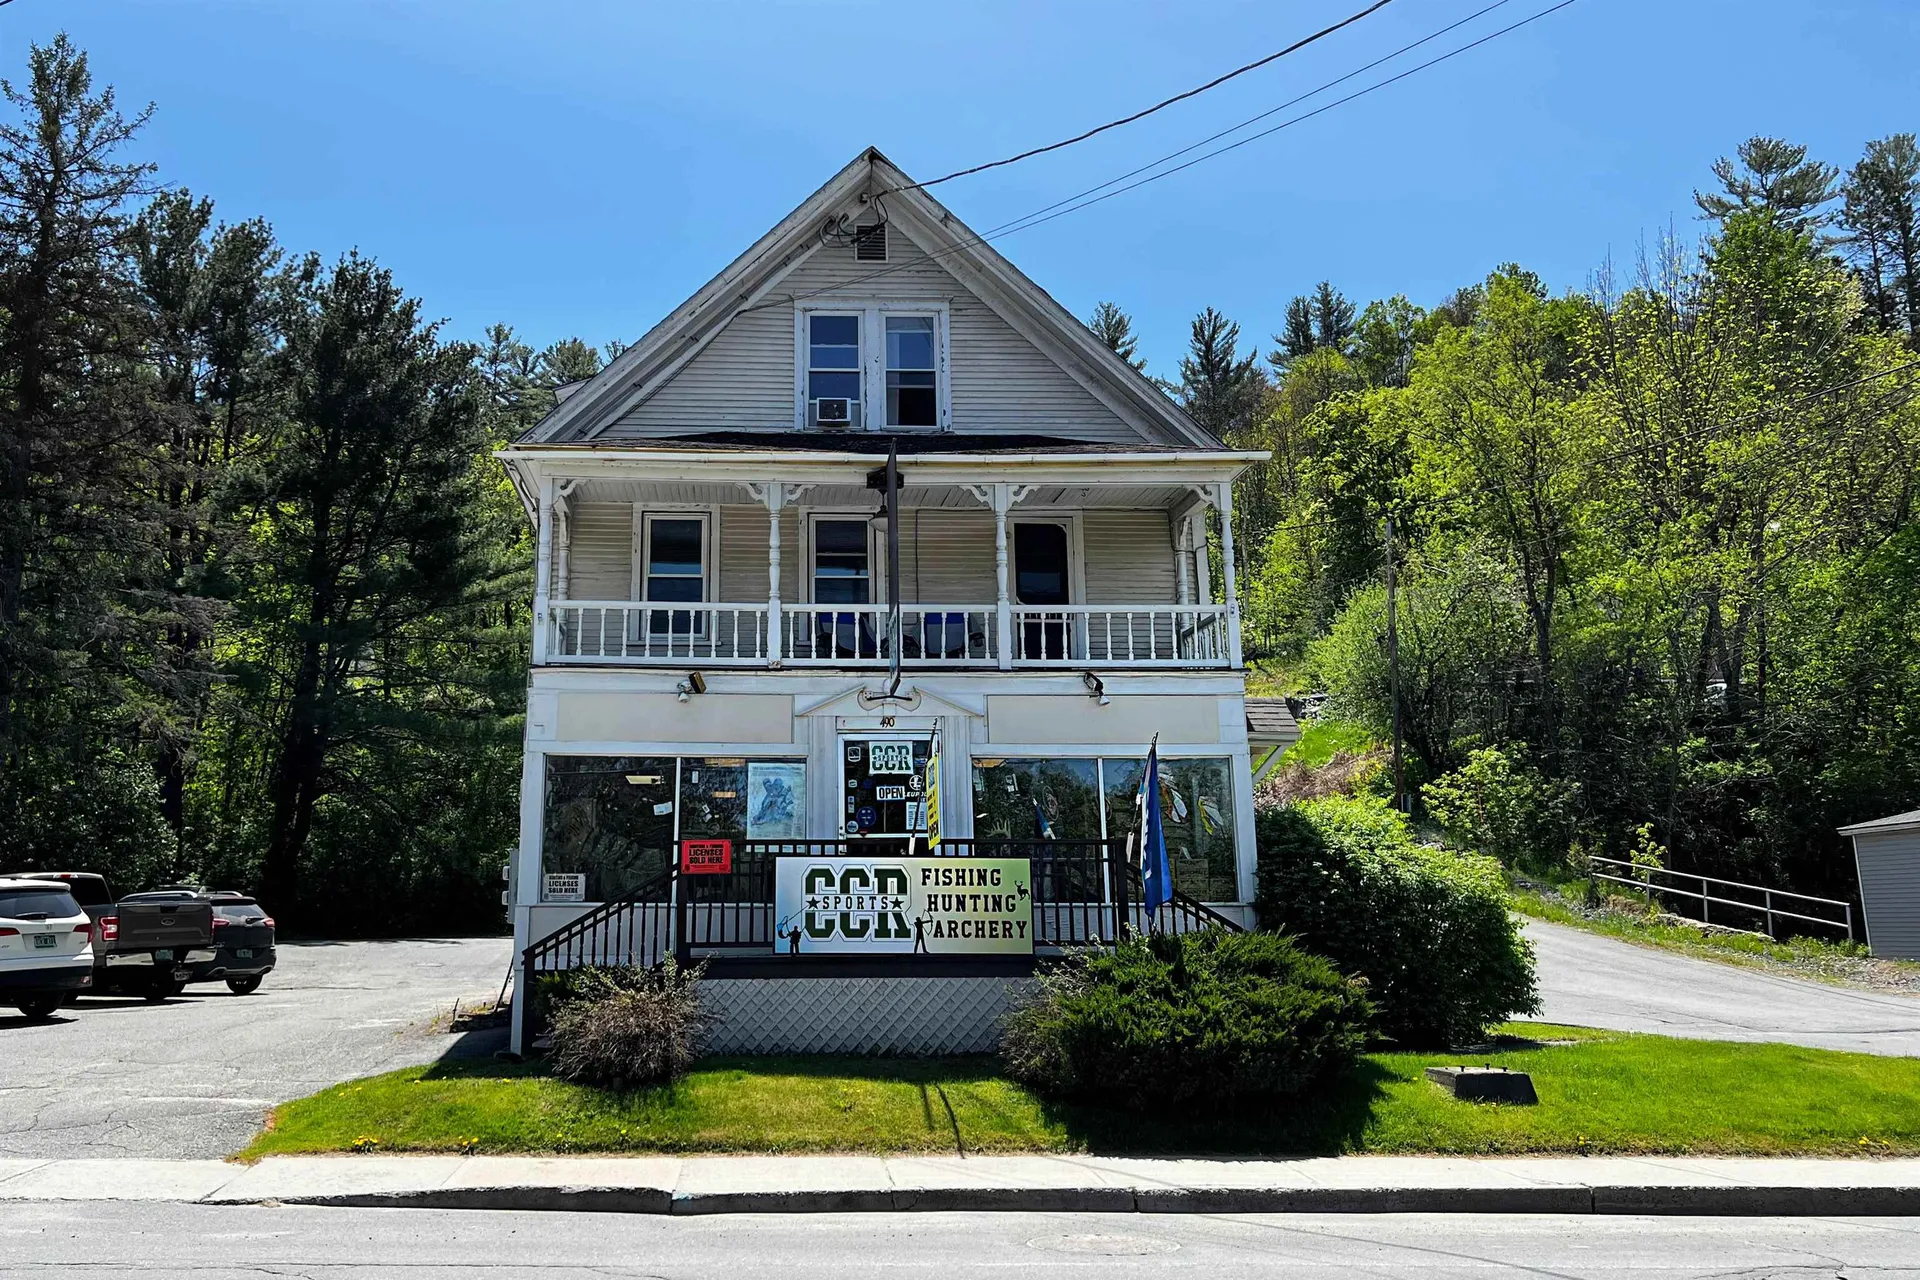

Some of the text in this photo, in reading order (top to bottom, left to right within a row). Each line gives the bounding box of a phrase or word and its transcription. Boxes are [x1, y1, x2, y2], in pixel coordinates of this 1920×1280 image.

[879, 717, 895, 728] 490
[871, 745, 912, 771] CCR
[878, 787, 904, 799] OPEN
[689, 849, 723, 857] LICENSES
[921, 868, 1001, 886] FISHING
[804, 868, 911, 939] CCR
[822, 895, 890, 910] SPORTS
[927, 894, 1016, 913] HUNTING
[933, 920, 1027, 939] ARCHERY
